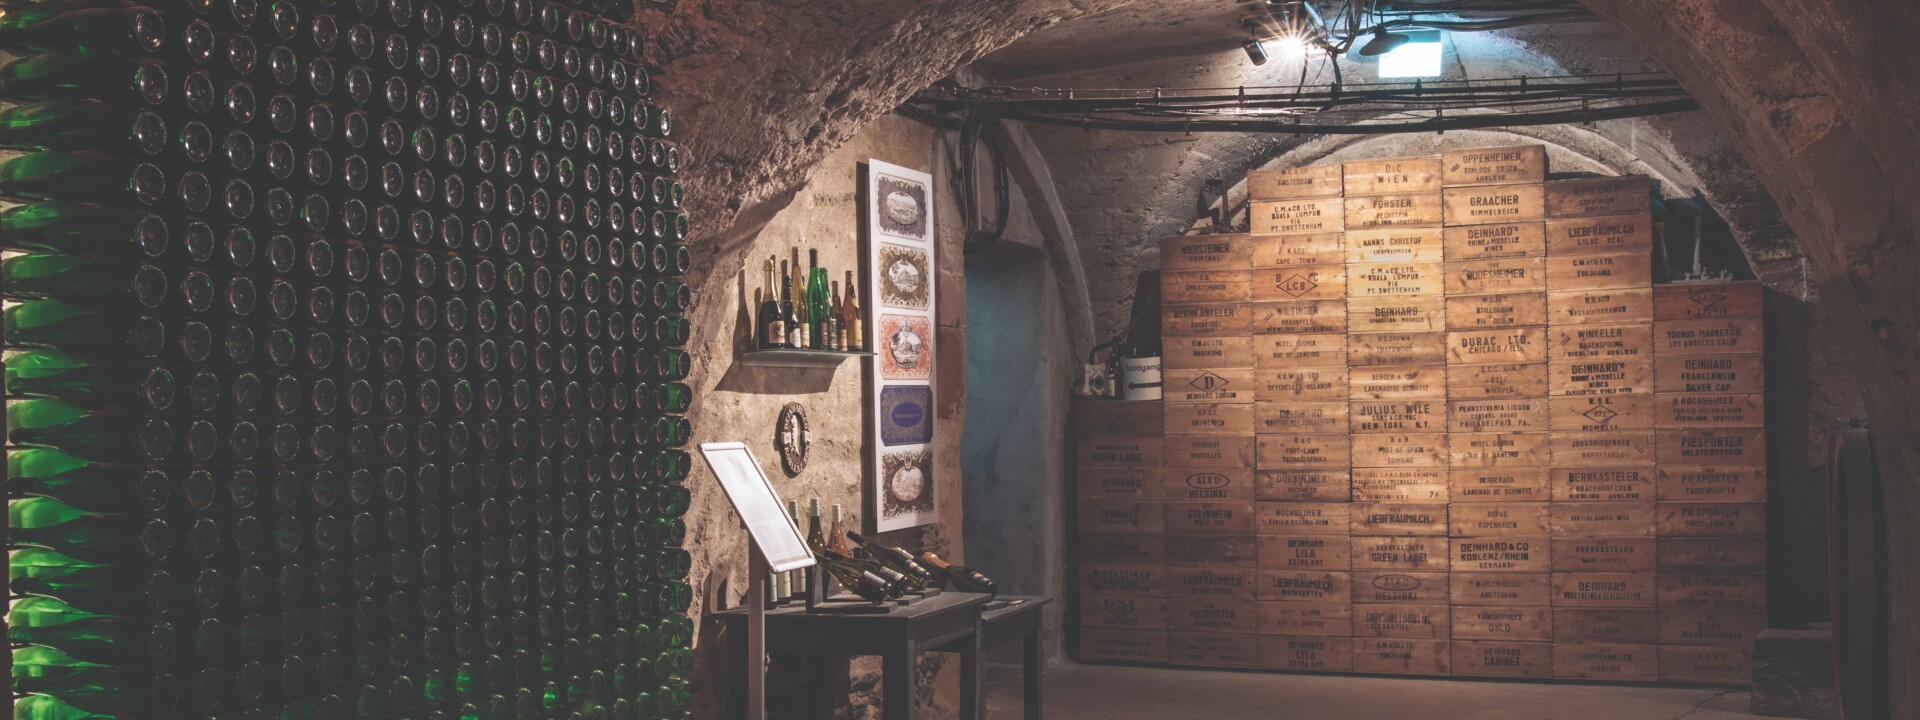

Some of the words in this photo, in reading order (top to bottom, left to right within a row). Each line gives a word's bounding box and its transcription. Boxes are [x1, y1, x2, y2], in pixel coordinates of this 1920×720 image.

[1463, 152, 1521, 162] OPPENHEIMER
[1497, 165, 1518, 173] SIEGER
[1373, 198, 1412, 208] FORSTER
[1470, 195, 1519, 206] GRAACHER
[1569, 224, 1635, 237] LIEBFRAUMILCH
[1390, 237, 1422, 245] CHRISTOF
[1490, 236, 1519, 244] MOSELLE
[1578, 238, 1598, 246] LILAC
[1181, 244, 1229, 254] NIERSTEINER
[1393, 272, 1419, 280] LUMPUR
[1387, 280, 1398, 288] VIA
[1174, 308, 1235, 318] BERNKASTELER
[1276, 306, 1318, 315] WILTINGER
[1375, 307, 1417, 317] DEINHARD
[1578, 329, 1623, 339] WINKELER
[1667, 330, 1695, 338] YOUNGS
[1699, 329, 1728, 337] MARKET
[1462, 337, 1496, 348] DURAC
[1508, 335, 1530, 345] LTD.
[1668, 339, 1681, 347] LOS
[1684, 338, 1715, 346] ANGELES
[1686, 359, 1732, 369] DEINHARD
[1681, 372, 1736, 380] FRANKENWEIN
[1204, 376, 1215, 389] D
[1686, 383, 1711, 392] SILVER
[1681, 397, 1734, 406] HOCHHEIMER
[1279, 409, 1322, 418] DEINHARD
[1360, 404, 1396, 416] JULIUS
[1406, 402, 1430, 414] WILE
[1362, 422, 1378, 430] NEW
[1416, 421, 1430, 429] N.Y.
[1572, 439, 1632, 447] JOHANNISBERGER
[1682, 436, 1743, 447] PIESPORTER
[1091, 453, 1116, 462] GREEN
[1120, 453, 1141, 462] LABEL
[1468, 451, 1478, 459] RIO
[1482, 451, 1489, 459] DE
[1197, 475, 1221, 484] ALKO
[1569, 472, 1639, 482] BERNKASTELER
[1682, 474, 1739, 483] PIESPORTER
[1102, 479, 1141, 489] DEINHARD
[1189, 490, 1227, 498] HELSINKI
[1463, 487, 1490, 495] LANGNAU
[1493, 487, 1502, 495] BE
[1505, 487, 1531, 495] SCHWEIZ
[1187, 510, 1232, 519] STEINWEIN
[1275, 508, 1321, 516] HOCHHEIMER
[1682, 507, 1739, 516] PIESPORTER
[1367, 514, 1429, 523] LIEBFRAUMILCH
[1460, 543, 1507, 552] DEINHARD
[1516, 542, 1529, 551] CO
[1296, 549, 1315, 558] LILA
[1372, 553, 1398, 562] GREEN
[1403, 553, 1428, 562] LABEL
[1273, 577, 1333, 591] LIEBFRAUMILCH
[1384, 578, 1409, 588] ALKO
[1579, 582, 1626, 591] DEINHARD
[1375, 591, 1417, 600] HELSINKI
[1489, 623, 1512, 632] OSLO
[1288, 641, 1324, 649] DEINHARD
[1296, 650, 1315, 660] LILA
[1579, 653, 1632, 661] LIEBFRAUMILCH
[1484, 657, 1520, 666] CABINET
